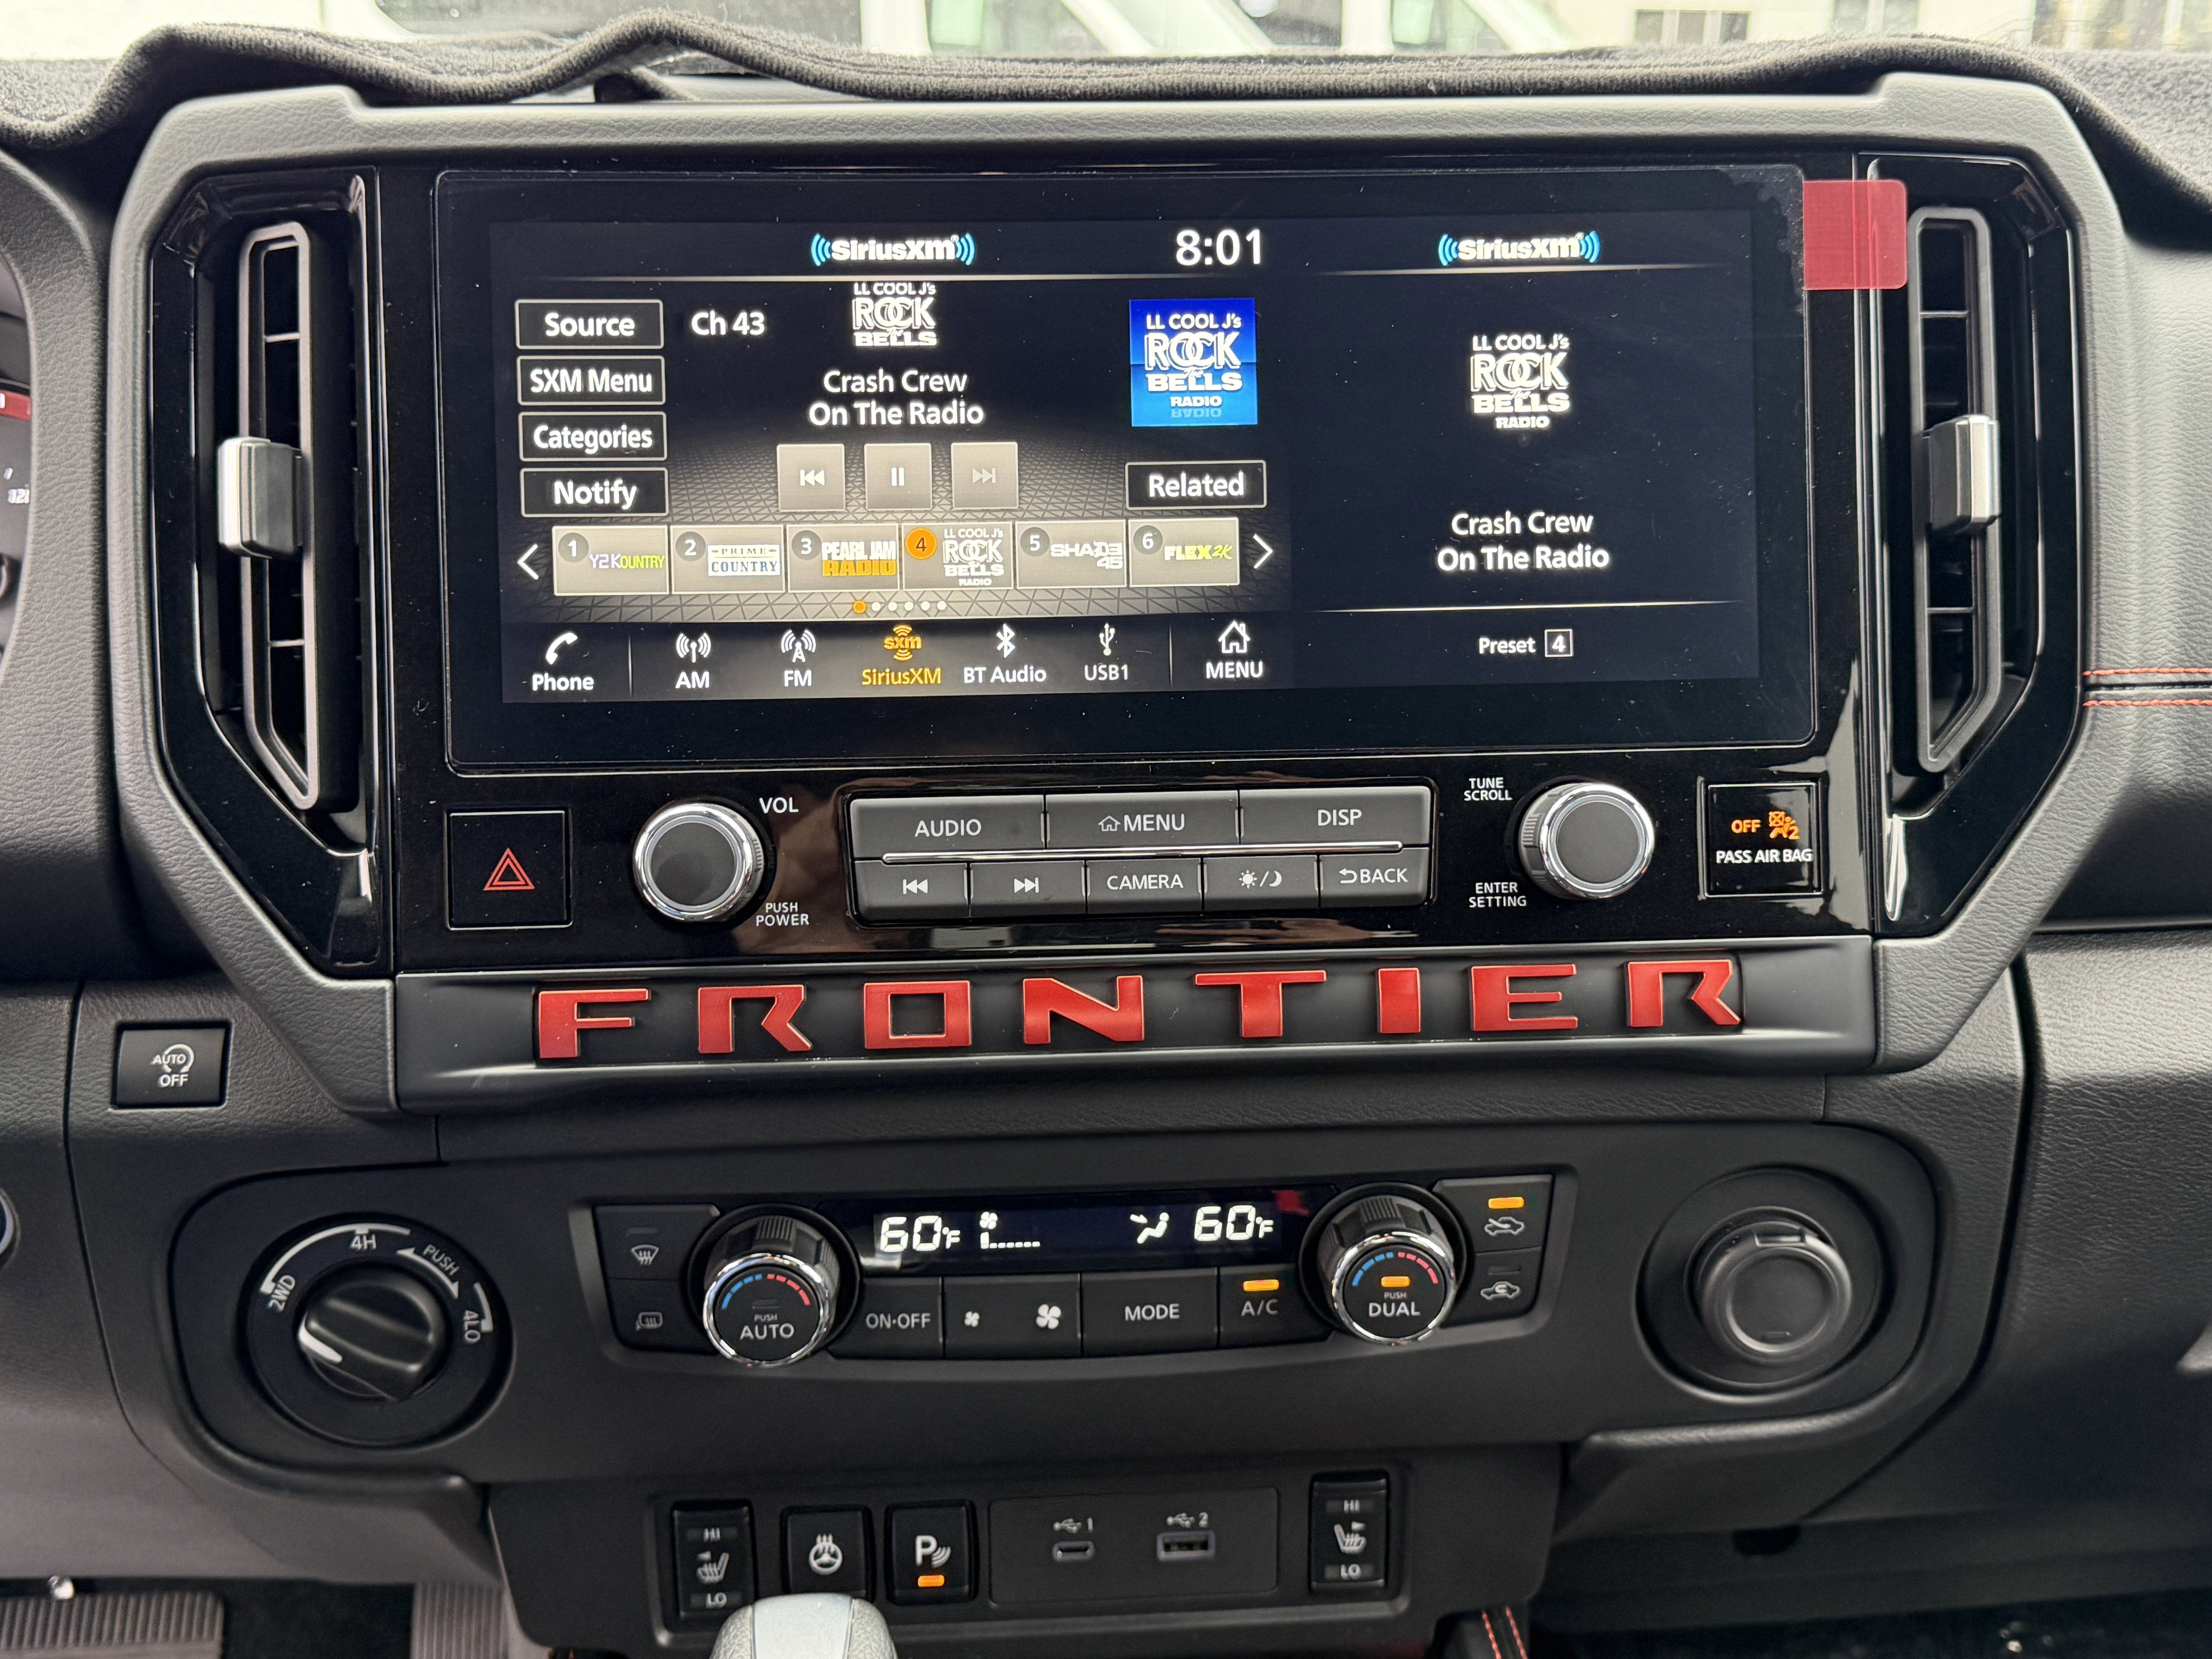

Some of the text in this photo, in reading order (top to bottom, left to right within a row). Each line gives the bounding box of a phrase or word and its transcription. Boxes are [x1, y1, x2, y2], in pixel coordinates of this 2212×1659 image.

[1175, 229, 1262, 265] 8:01
[854, 283, 870, 295] LL
[873, 283, 916, 295] COOL
[853, 297, 935, 330] ROCK
[1147, 313, 1242, 329] LL COOL J's
[545, 313, 635, 337] Source
[692, 310, 764, 335] Ch 43
[854, 331, 937, 346] BELLS
[1473, 333, 1570, 350] LL COOL J's
[1144, 331, 1241, 370] ROCK
[824, 368, 967, 392] Crash Crew
[1470, 352, 1569, 392] ROCK
[530, 369, 652, 393] SXM Menu
[1146, 372, 1242, 391] BELLS
[1170, 396, 1222, 407] RADIO
[1472, 393, 1570, 413] BELLS
[809, 398, 984, 425] On The Radio
[1495, 416, 1549, 428] RADIO
[534, 423, 653, 454] Categories
[1148, 471, 1244, 498] Related
[554, 477, 637, 510] Notify
[1451, 510, 1593, 535] Crash Crew
[944, 529, 956, 538] LL
[958, 528, 989, 538] COOL
[1142, 534, 1154, 549] 6
[568, 540, 577, 557] 1
[684, 539, 697, 556] 2
[800, 538, 812, 555] 3
[822, 541, 896, 560] PEARL JAM
[915, 538, 926, 551] 4
[943, 539, 1003, 563] ROCK
[1030, 535, 1040, 551] 5
[1097, 556, 1123, 569] 45
[1437, 543, 1609, 570] On The Radio
[711, 560, 778, 573] COUNTRY
[822, 560, 896, 576] RADIO
[944, 564, 1004, 576] BELLS
[1479, 635, 1566, 654] Preset 4
[862, 668, 941, 685] SiriusXM
[963, 666, 1046, 683] BT Audio
[1084, 663, 1128, 681] USB1
[1206, 661, 1262, 678] MENU
[532, 673, 594, 691] Phone
[675, 672, 709, 689] AM
[784, 671, 812, 687] FM
[1468, 778, 1503, 789] TUNE
[1464, 790, 1512, 801] SCROLL
[759, 798, 799, 813] VOL
[1124, 814, 1185, 831] MENU
[1317, 809, 1362, 826] DISP
[1731, 819, 1761, 833] OFF
[915, 819, 981, 837] AUDIO
[1716, 848, 1813, 863] PASS AIR BAG
[1107, 874, 1183, 890] CAMERA
[1360, 868, 1408, 883] BACK
[1475, 882, 1517, 894] ENTER
[765, 902, 798, 912] PUSH
[1469, 896, 1527, 907] SETTING
[756, 914, 809, 926] POWER
[536, 958, 1742, 1062] FRONTIER
[151, 1054, 186, 1065] AUTO
[157, 1074, 188, 1087] OFF
[351, 1234, 376, 1250] 4H
[423, 1244, 460, 1276] PUSH
[267, 1275, 295, 1312] 2WD
[1125, 1303, 1180, 1321] MODE
[1241, 1299, 1278, 1316] A/C
[1369, 1301, 1420, 1316] DUAL
[464, 1310, 480, 1344] 4LO
[740, 1324, 794, 1340] AUTO
[1344, 1500, 1360, 1512] HI
[1087, 1518, 1093, 1532] 1
[1199, 1512, 1209, 1527] 2
[704, 1528, 720, 1541] HI
[1340, 1564, 1361, 1579] LO
[706, 1593, 727, 1607] LO
